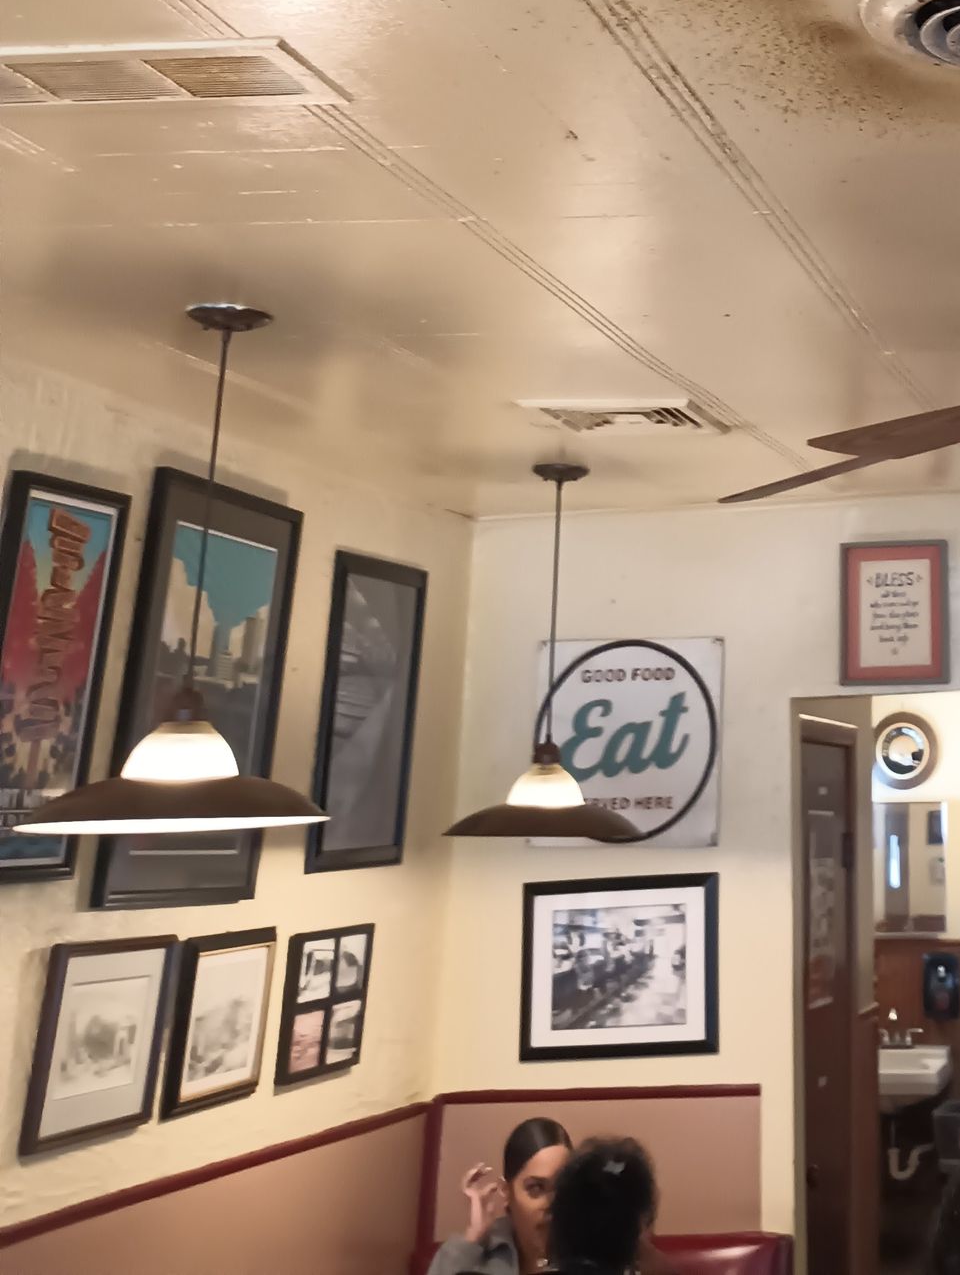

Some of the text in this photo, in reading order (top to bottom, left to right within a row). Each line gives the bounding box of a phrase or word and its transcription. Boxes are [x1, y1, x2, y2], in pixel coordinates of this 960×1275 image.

[581, 667, 675, 683] GOOD FOOD
[560, 691, 690, 782] Eat
[633, 796, 673, 810] HERE
